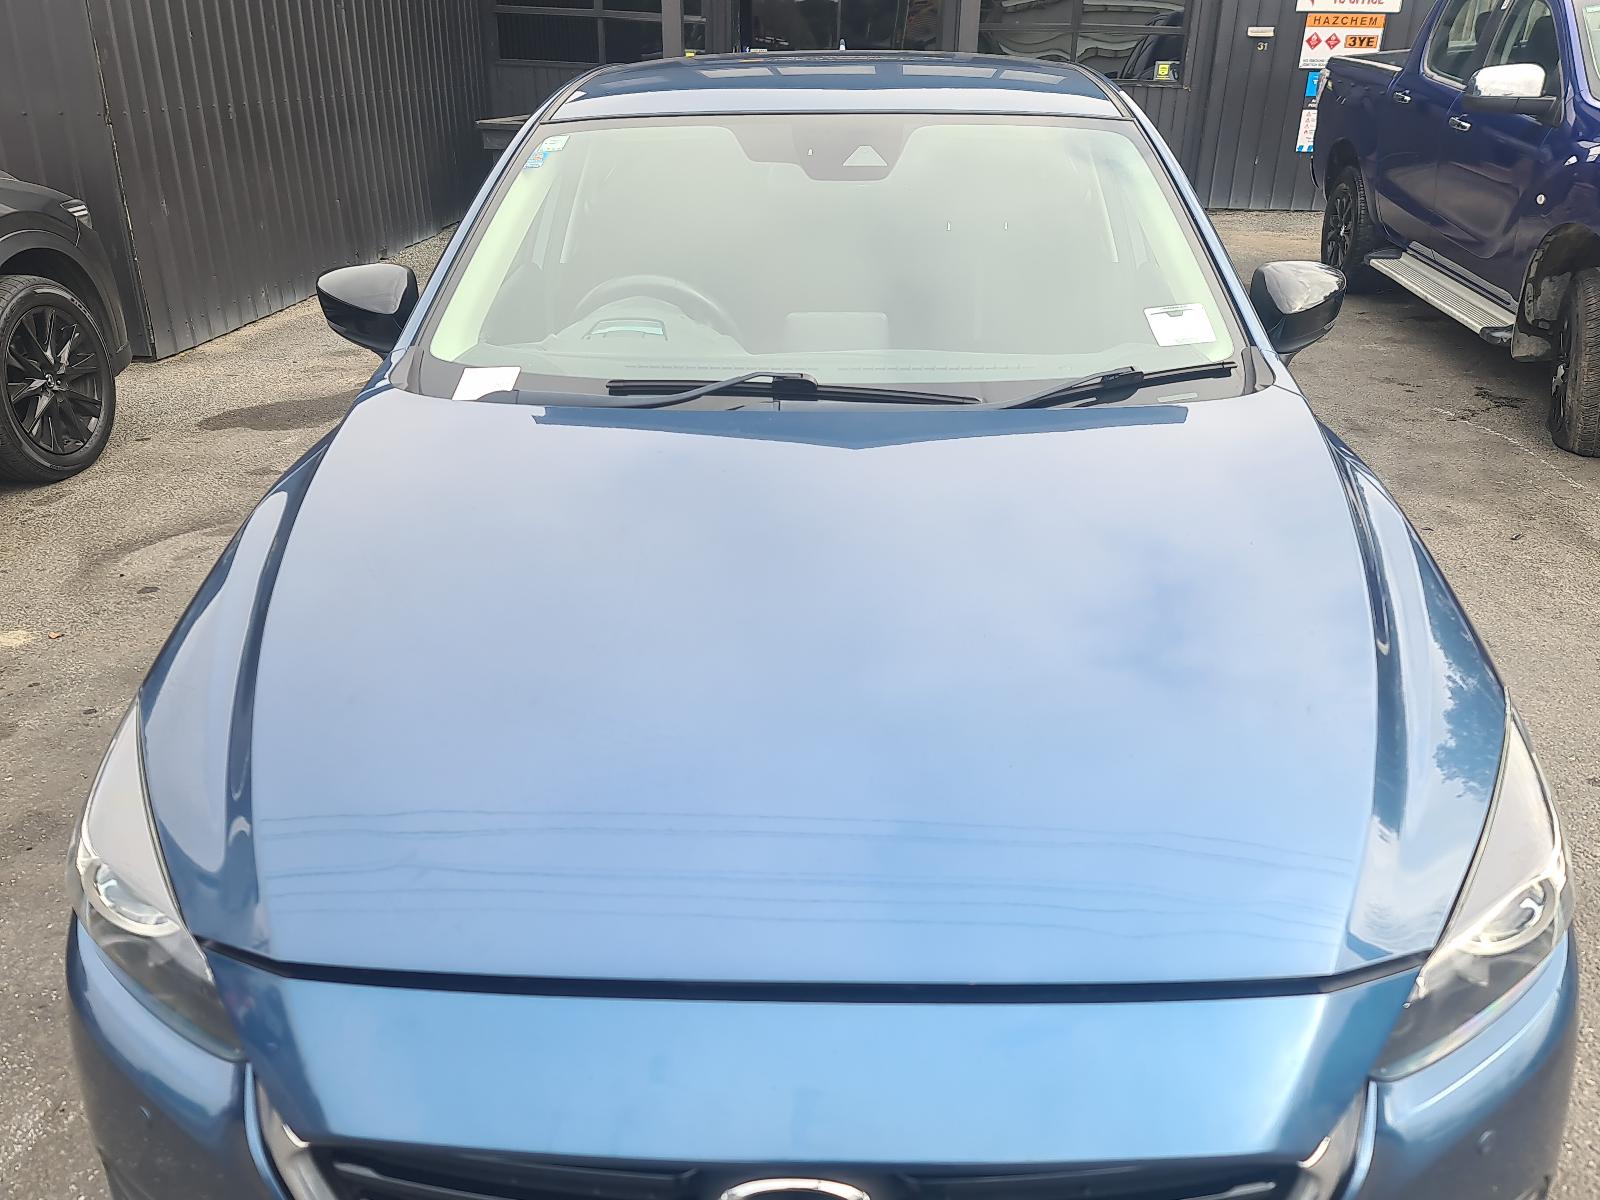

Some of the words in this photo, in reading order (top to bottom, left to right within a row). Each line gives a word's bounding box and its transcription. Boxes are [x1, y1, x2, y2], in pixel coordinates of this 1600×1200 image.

[1313, 15, 1378, 26] HAZCHEM
[1257, 41, 1268, 51] 31
[1348, 36, 1375, 47] 3YE
